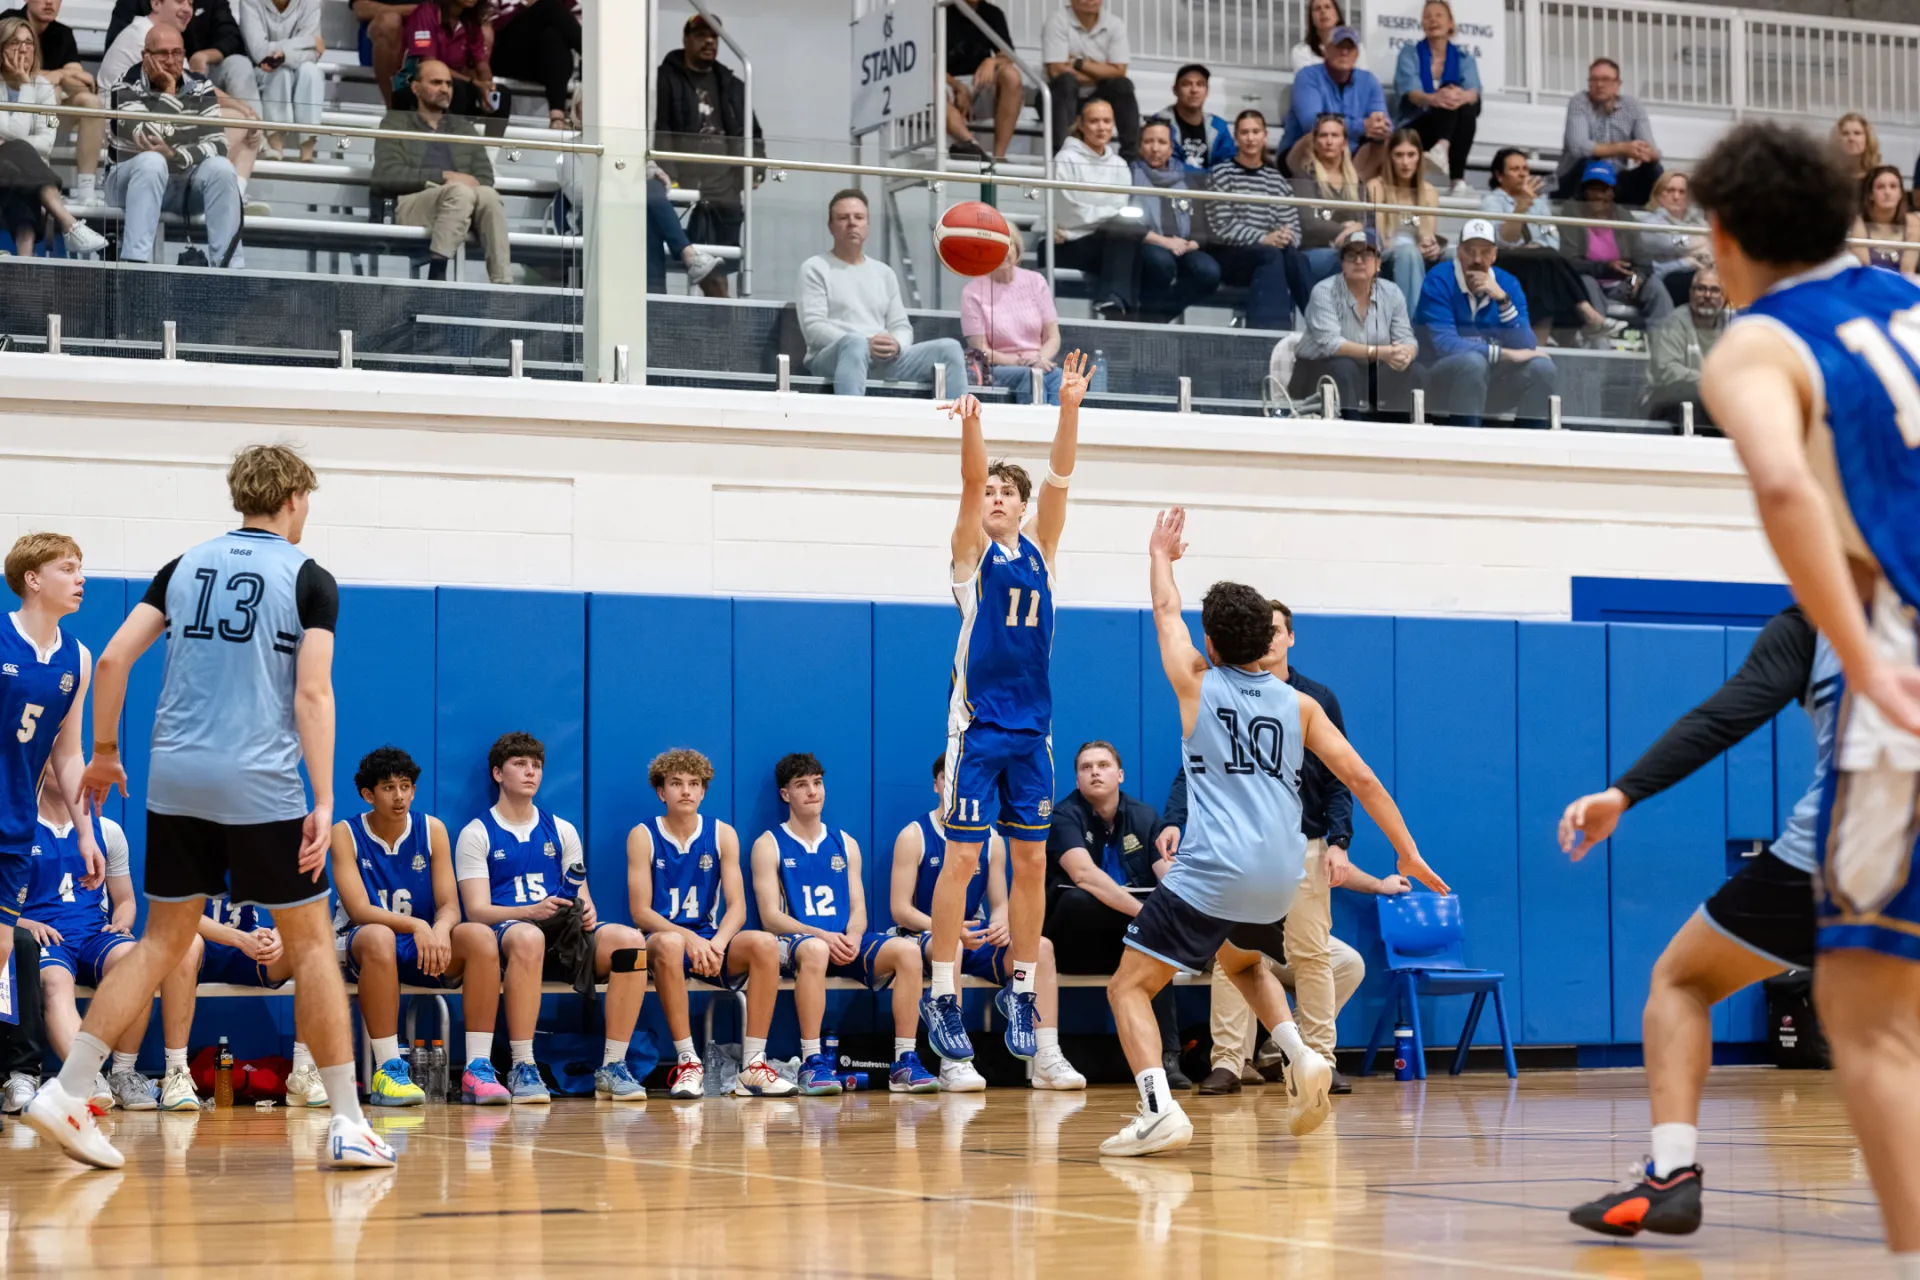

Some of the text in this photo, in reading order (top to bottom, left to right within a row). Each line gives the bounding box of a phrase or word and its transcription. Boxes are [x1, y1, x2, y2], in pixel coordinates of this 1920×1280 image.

[1377, 15, 1422, 31] RESERV
[861, 40, 916, 86] STAND
[882, 85, 891, 116] 2
[229, 548, 253, 556] 1868
[183, 567, 265, 644] 13
[1005, 587, 1040, 628] 11
[16, 702, 45, 744] 5
[1216, 707, 1284, 780] 10
[958, 797, 980, 822] 11
[58, 872, 76, 903] 4
[377, 888, 413, 917] 16
[513, 872, 549, 903] 15
[668, 885, 700, 920] 14
[801, 885, 837, 917] 12
[211, 899, 242, 929] 13
[851, 1059, 891, 1069] Manfrotto
